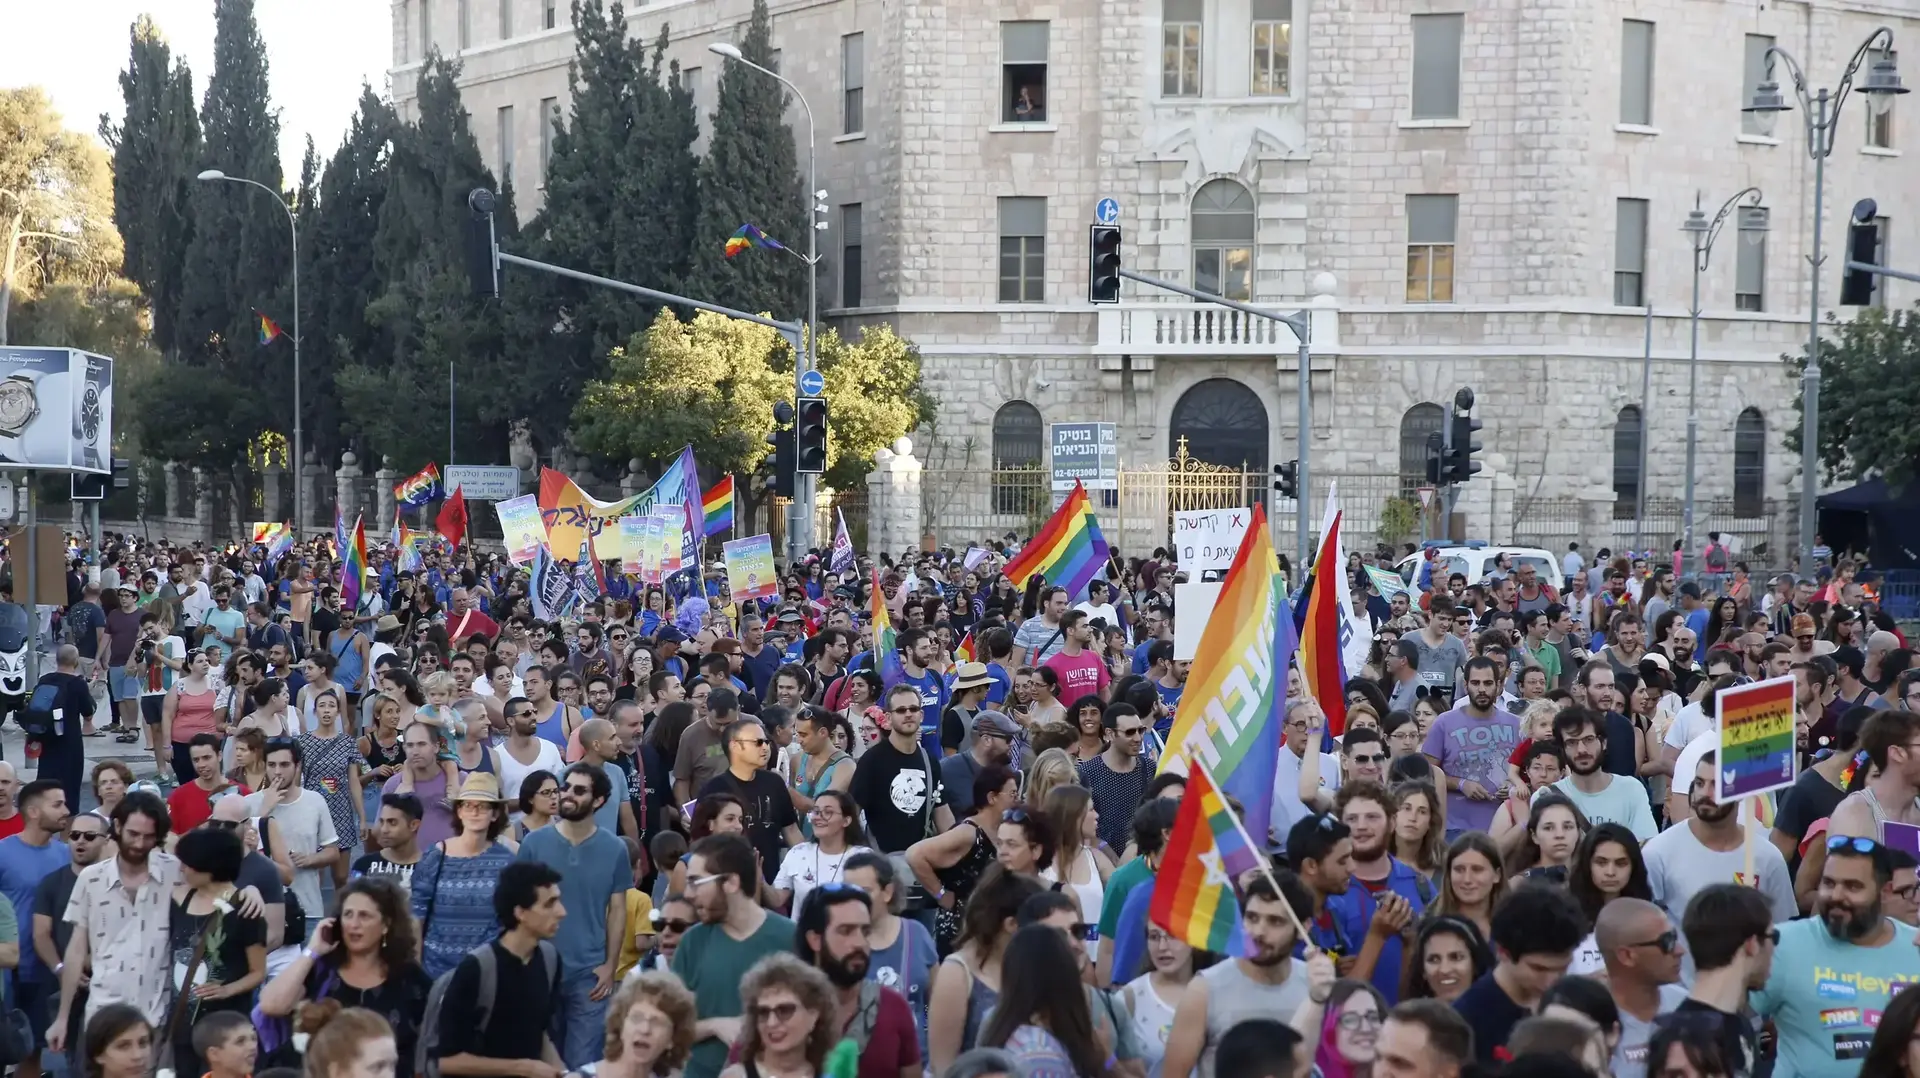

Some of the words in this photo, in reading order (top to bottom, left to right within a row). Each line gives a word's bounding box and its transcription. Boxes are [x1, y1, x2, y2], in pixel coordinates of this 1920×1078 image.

[1059, 429, 1091, 444] בוטיק
[1053, 443, 1098, 456] הנביאים
[1179, 513, 1219, 533] קדושה
[1065, 668, 1088, 683] חושן
[1450, 724, 1514, 747] TOM
